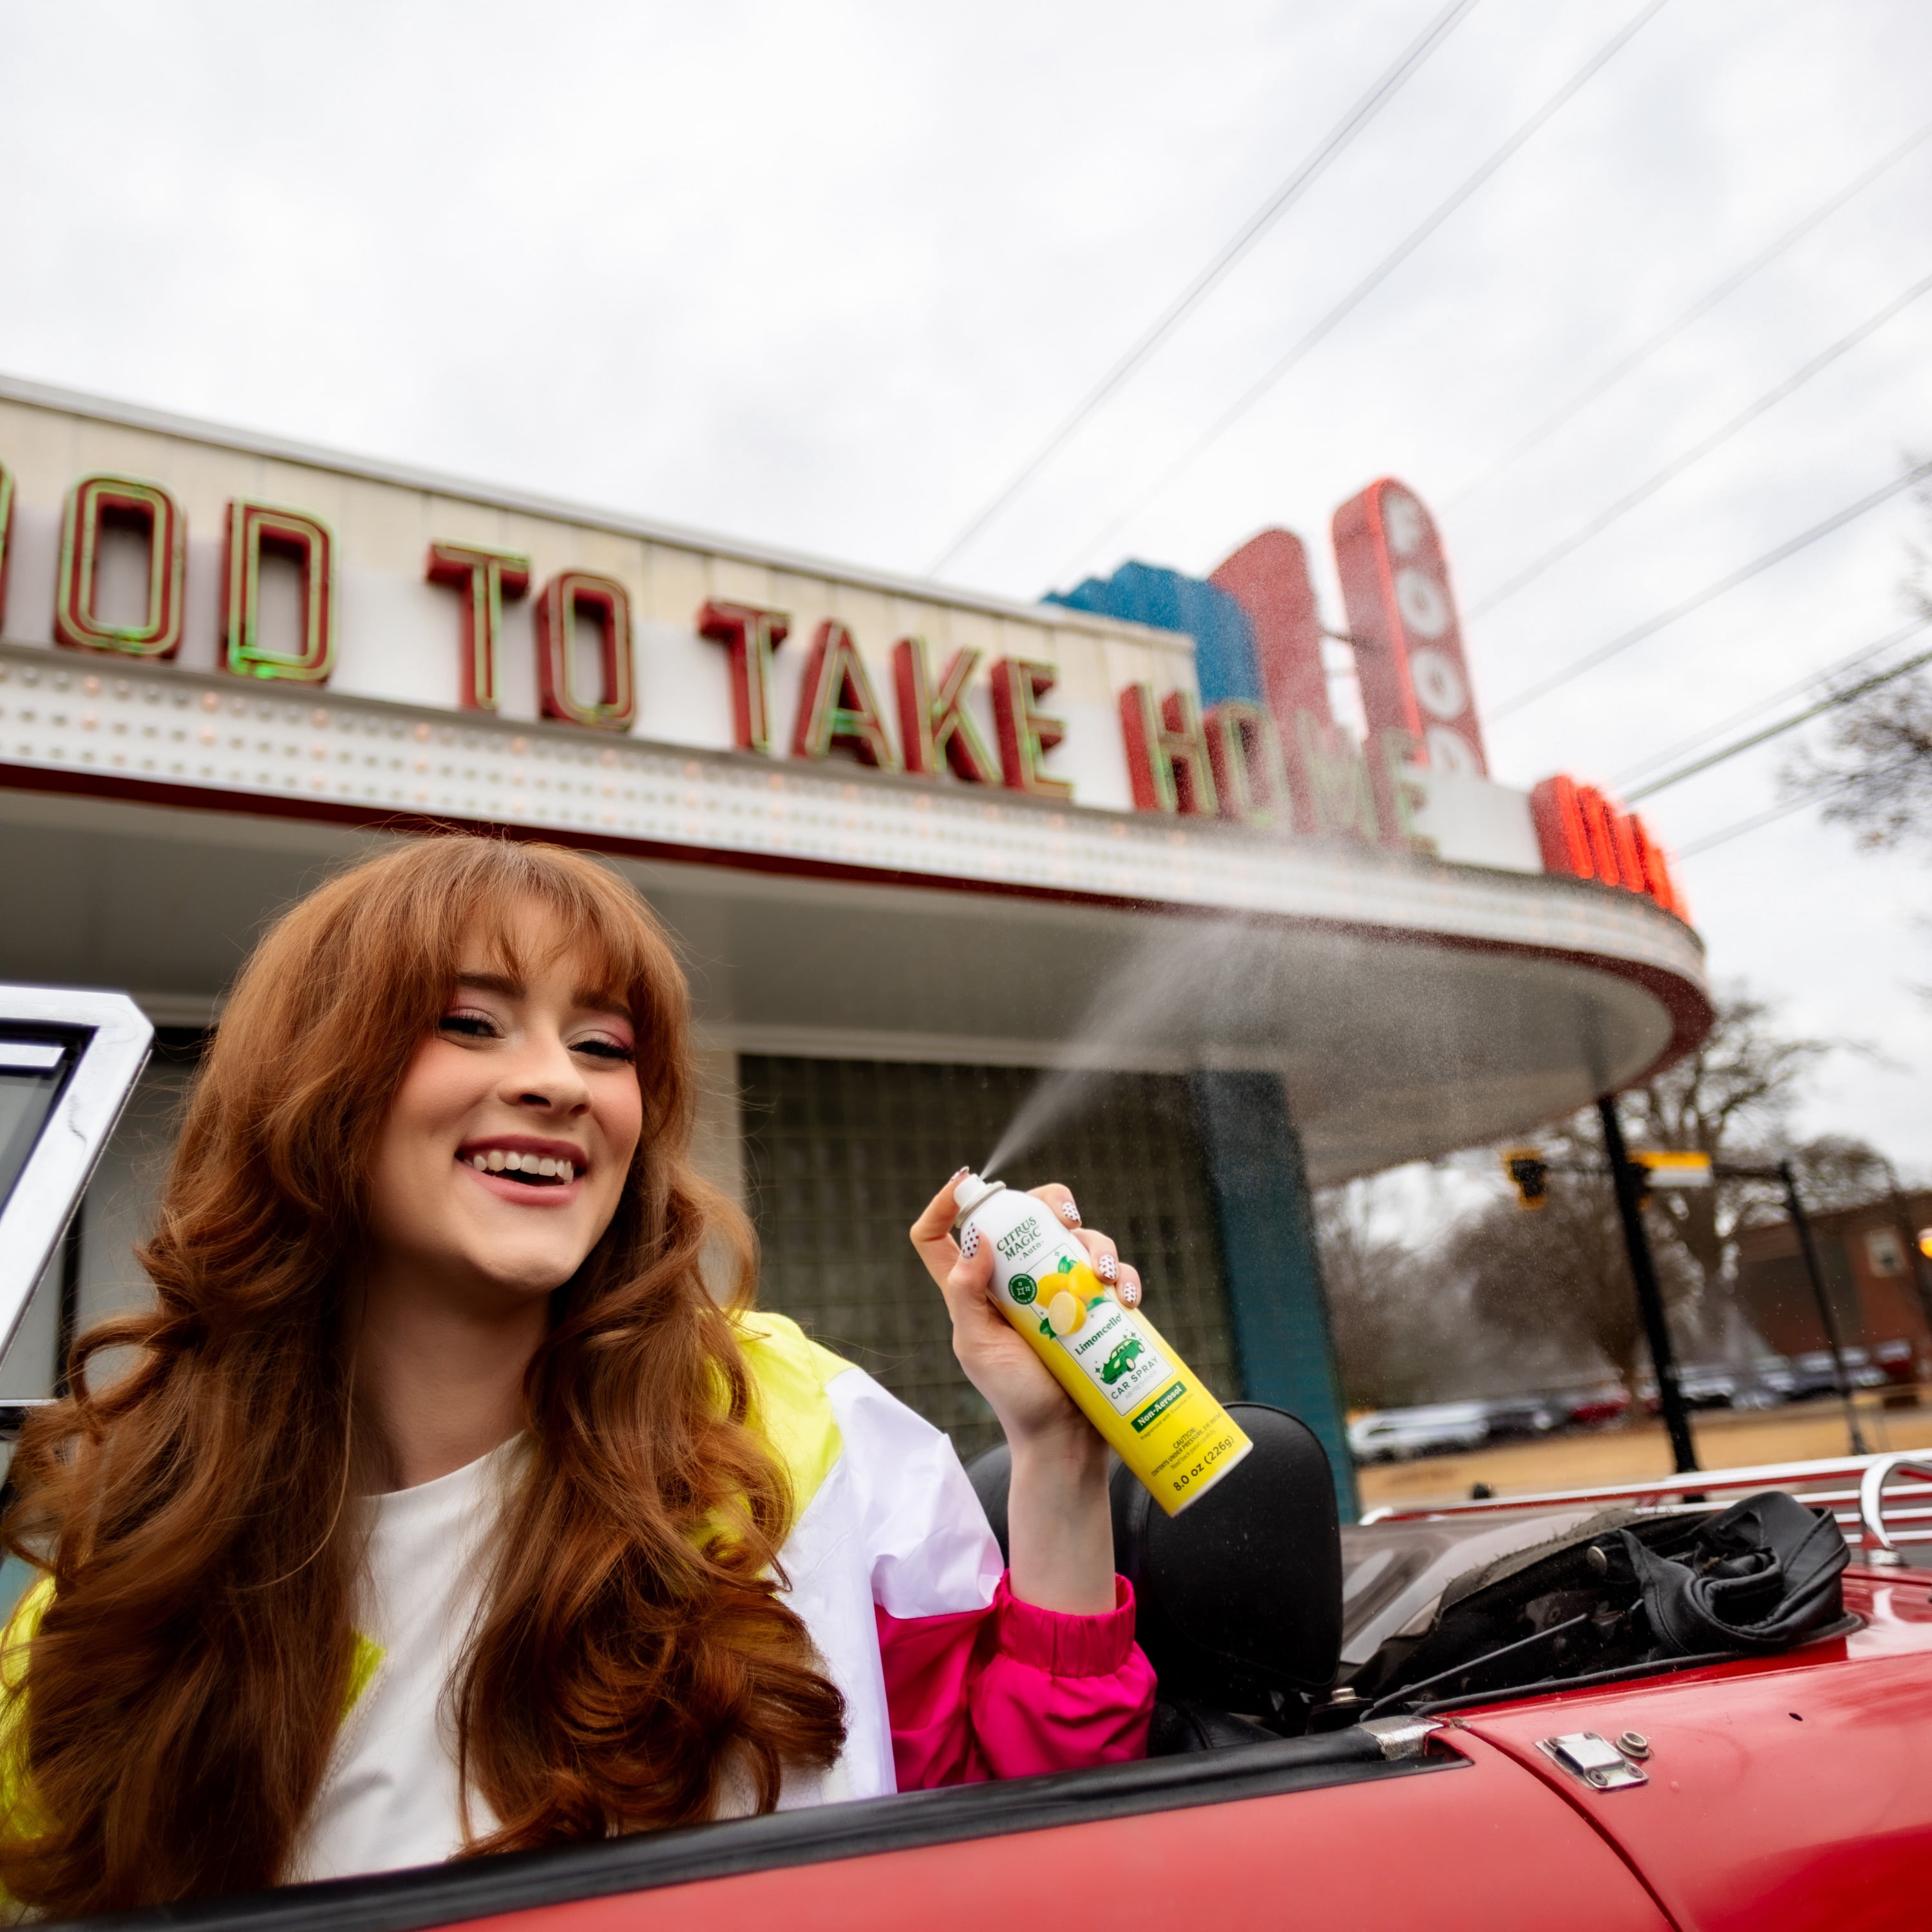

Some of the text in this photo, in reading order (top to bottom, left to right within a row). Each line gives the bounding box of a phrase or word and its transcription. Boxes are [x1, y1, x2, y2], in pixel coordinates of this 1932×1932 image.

[0, 460, 1440, 855] OD TO TAKE HOME
[997, 1217, 1036, 1251] CITRUS
[1004, 1227, 1041, 1262] MAGIC
[1023, 1243, 1041, 1260] Auto
[1075, 1313, 1122, 1356] Limoncello
[1112, 1356, 1159, 1399] CAR SPRAY
[1137, 1385, 1183, 1426] Non-Aerosol
[1173, 1427, 1197, 1449] CAUTION:
[1151, 1459, 1170, 1477] CONTENTS
[1168, 1447, 1184, 1463] UNDER
[1173, 1436, 1234, 1492] 8.0 oz (226g)
